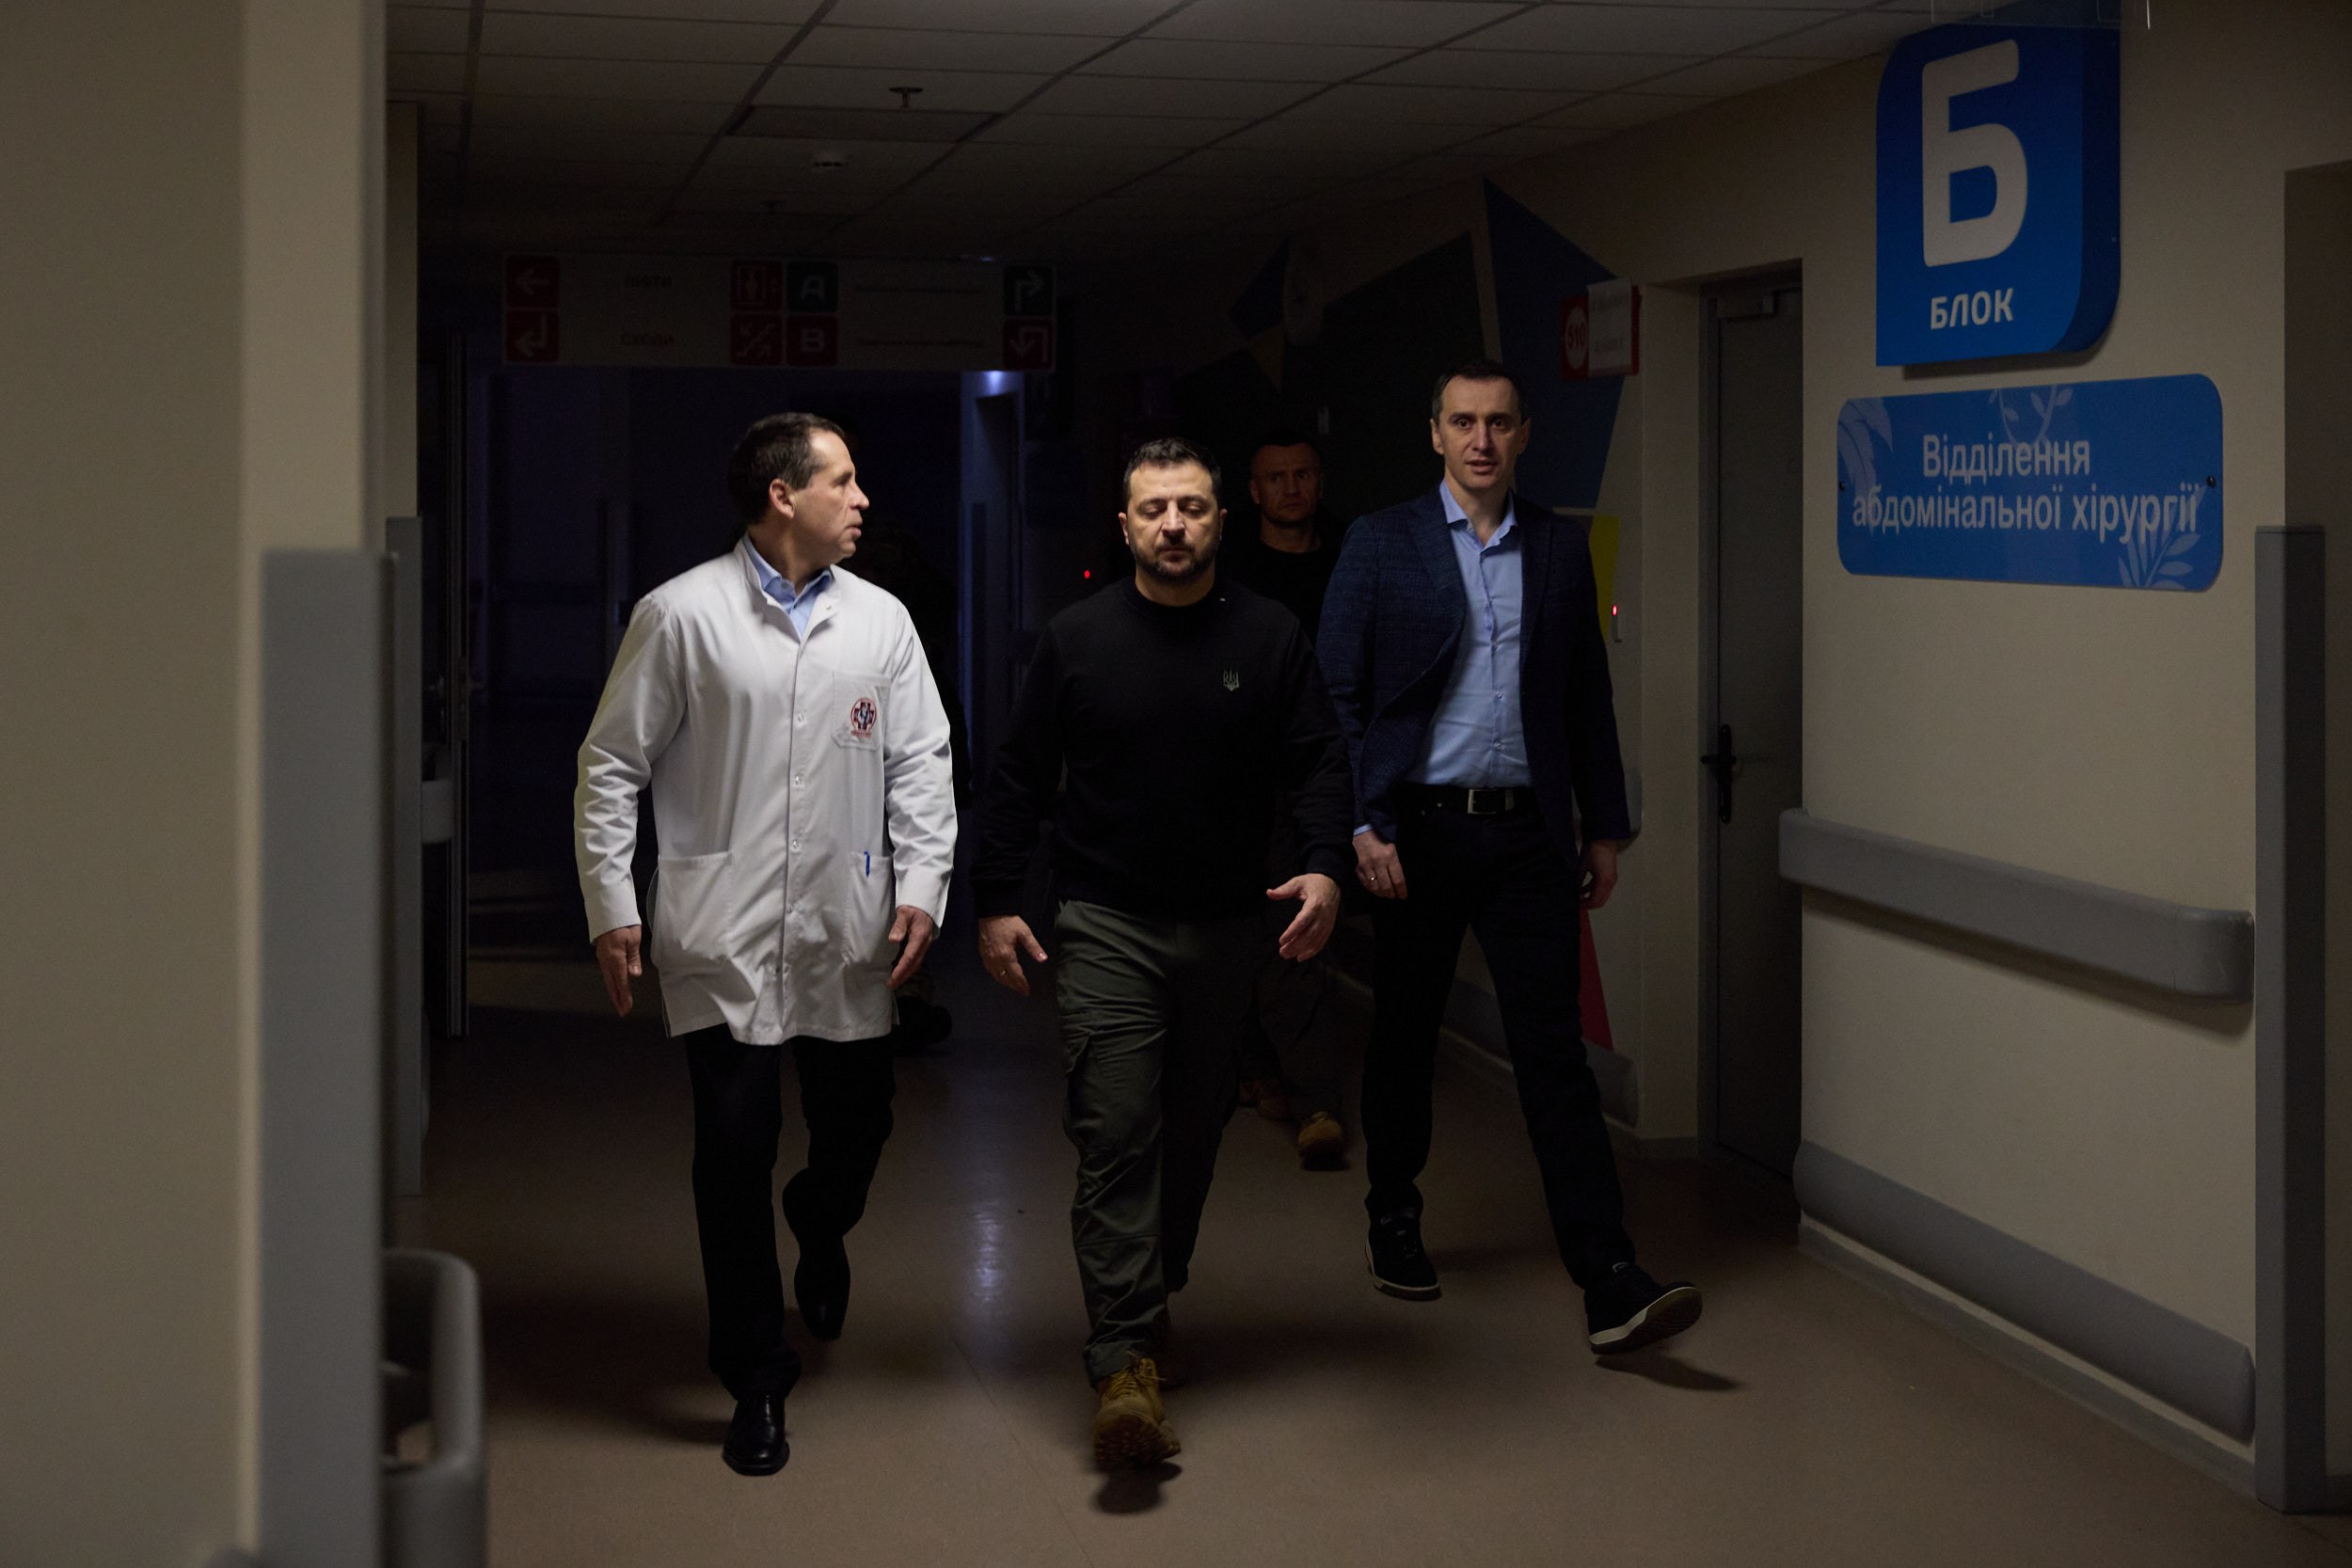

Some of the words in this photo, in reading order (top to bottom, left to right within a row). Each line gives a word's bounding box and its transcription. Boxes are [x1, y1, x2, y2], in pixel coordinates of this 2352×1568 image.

[1922, 39, 2028, 268] Б
[1931, 288, 2014, 330] БЛОК
[1922, 434, 2090, 485] Відділення
[1852, 486, 2061, 533] абдомінальної
[2072, 482, 2199, 545] хірургії
